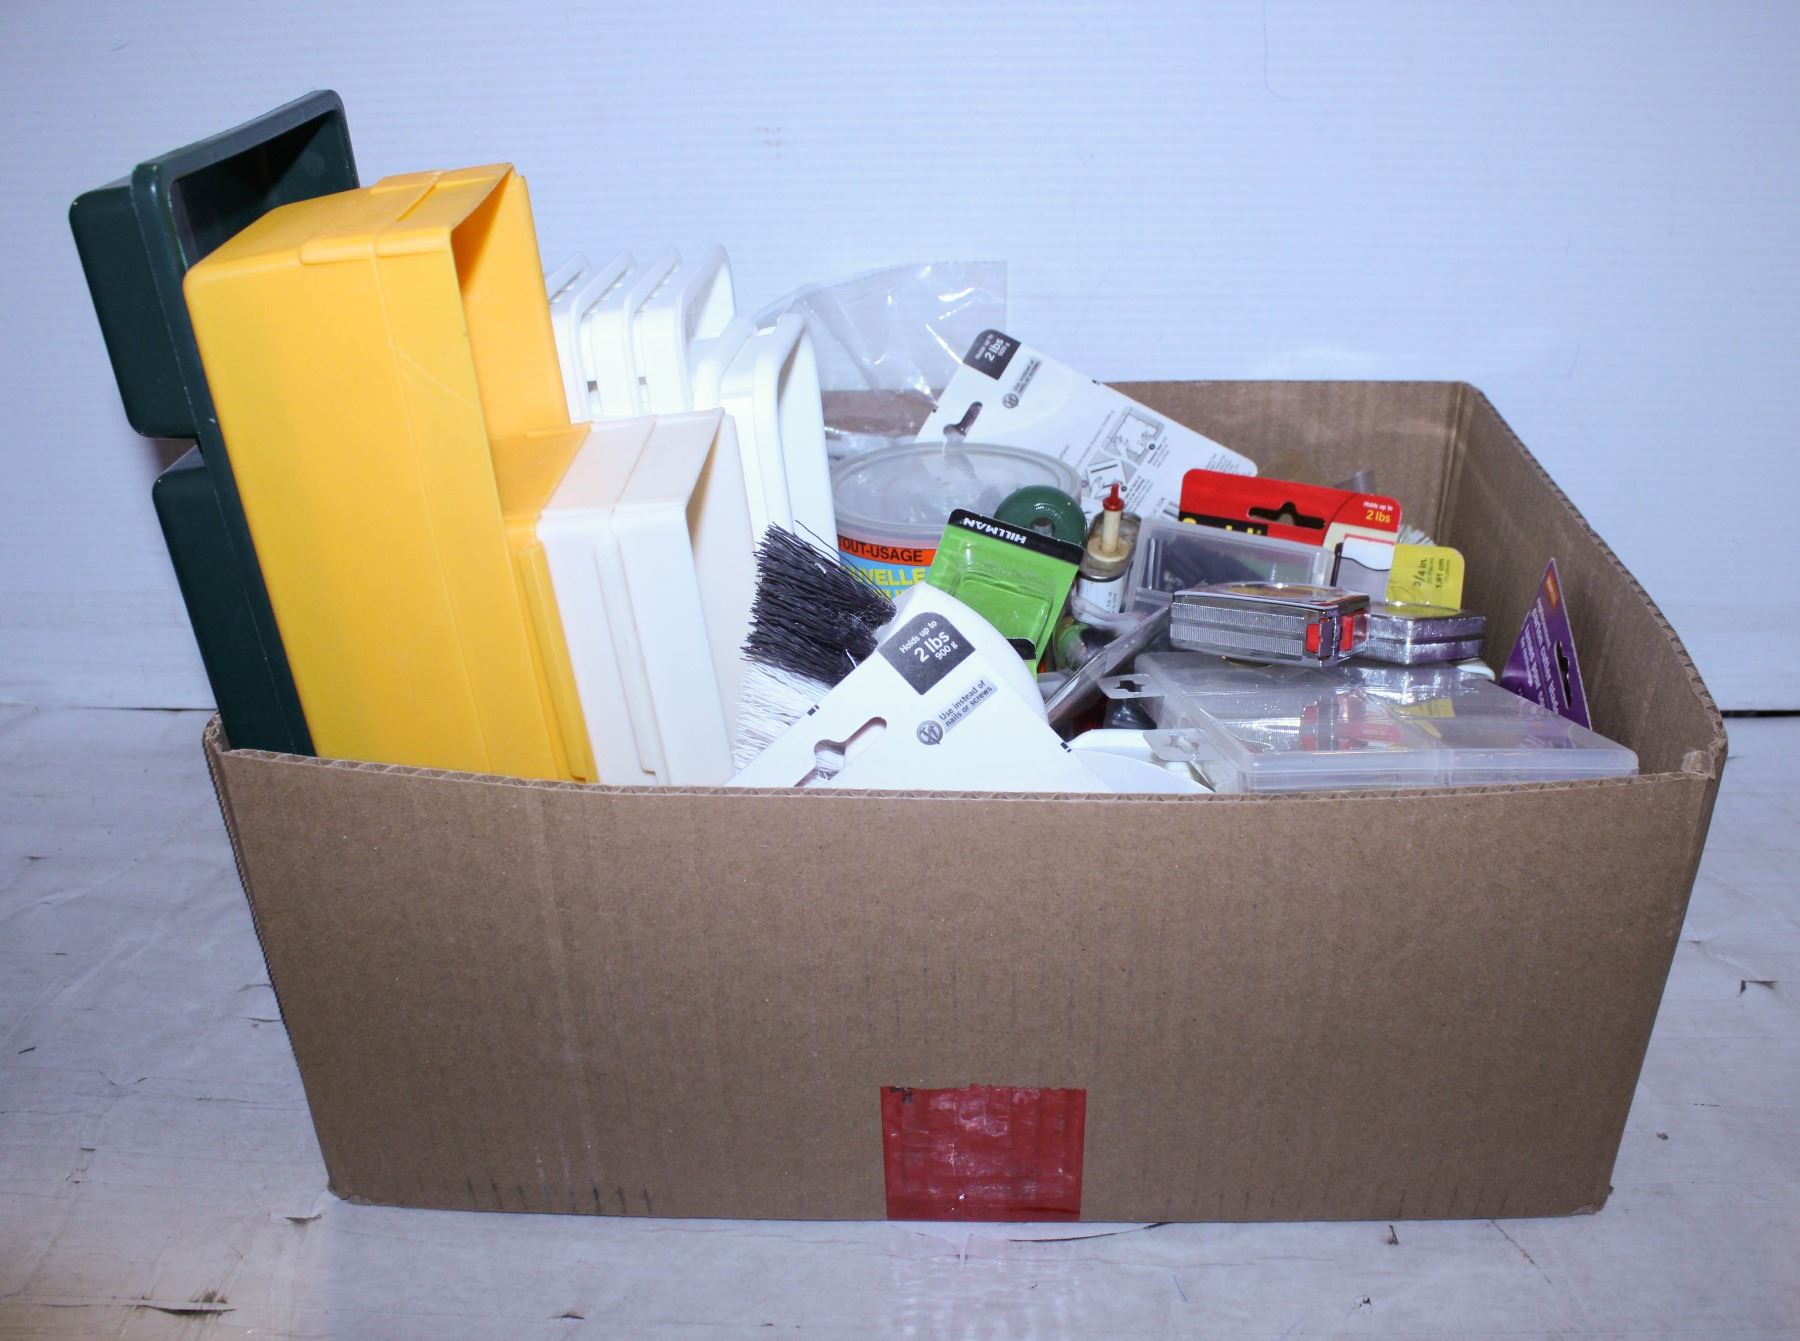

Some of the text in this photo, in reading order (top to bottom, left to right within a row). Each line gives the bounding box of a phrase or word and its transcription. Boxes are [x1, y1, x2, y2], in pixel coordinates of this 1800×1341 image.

[983, 337, 1004, 362] 2 lbs
[962, 517, 1027, 544] HILLMAN
[1365, 509, 1391, 524] 2 lbs
[899, 620, 938, 654] Holds up to
[914, 631, 950, 662] 2 lbs
[935, 640, 959, 660] 900 g
[938, 679, 986, 721] Use instead of
[945, 685, 993, 727] nails or screws
